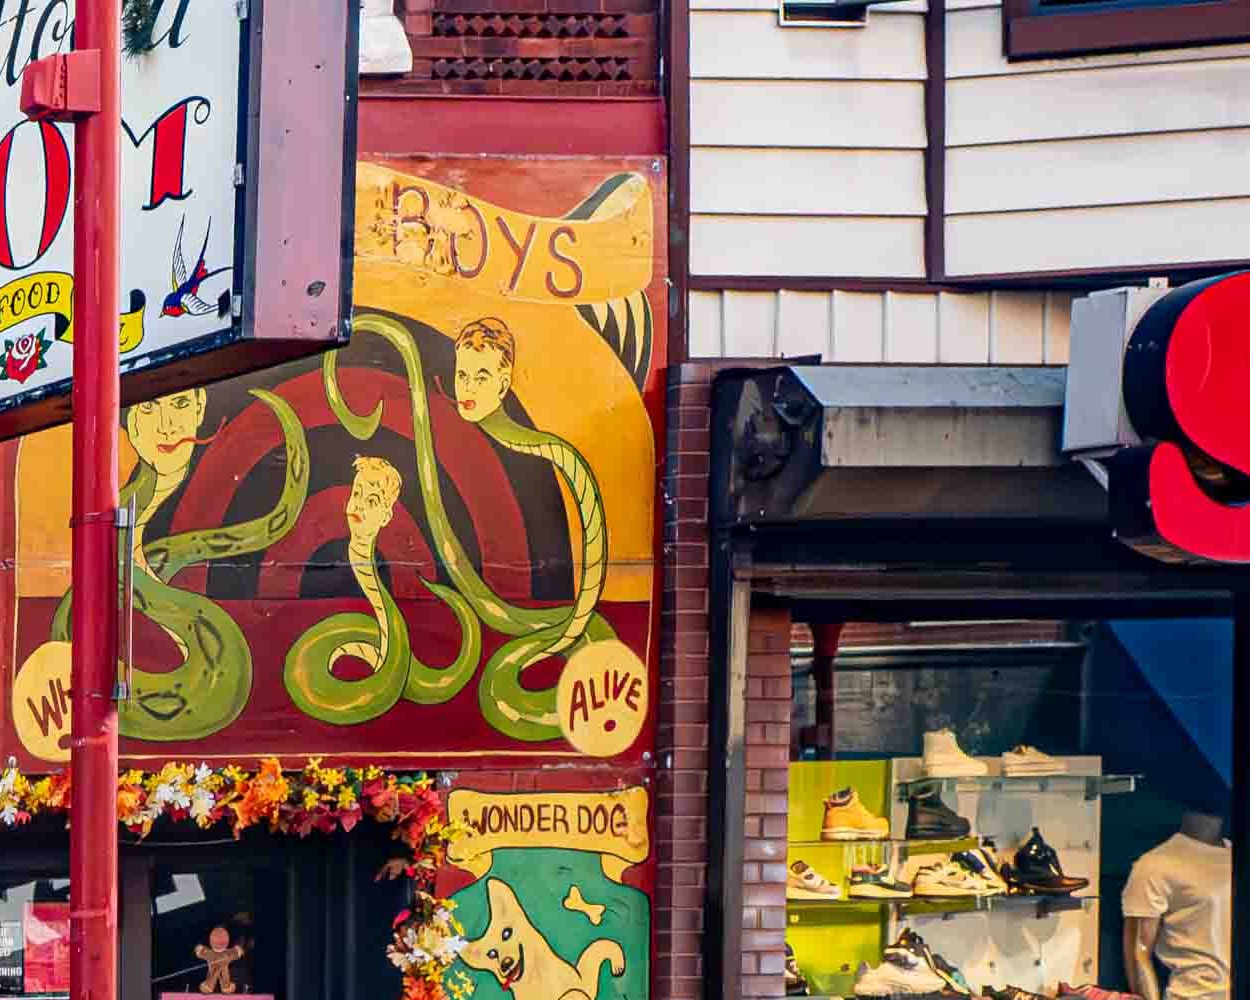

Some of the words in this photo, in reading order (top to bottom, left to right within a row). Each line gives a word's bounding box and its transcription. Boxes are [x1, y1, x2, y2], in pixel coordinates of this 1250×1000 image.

[391, 181, 583, 299] BOYS
[568, 670, 643, 732] ALIVE
[462, 803, 570, 838] WONDER
[577, 803, 629, 837] DOG
